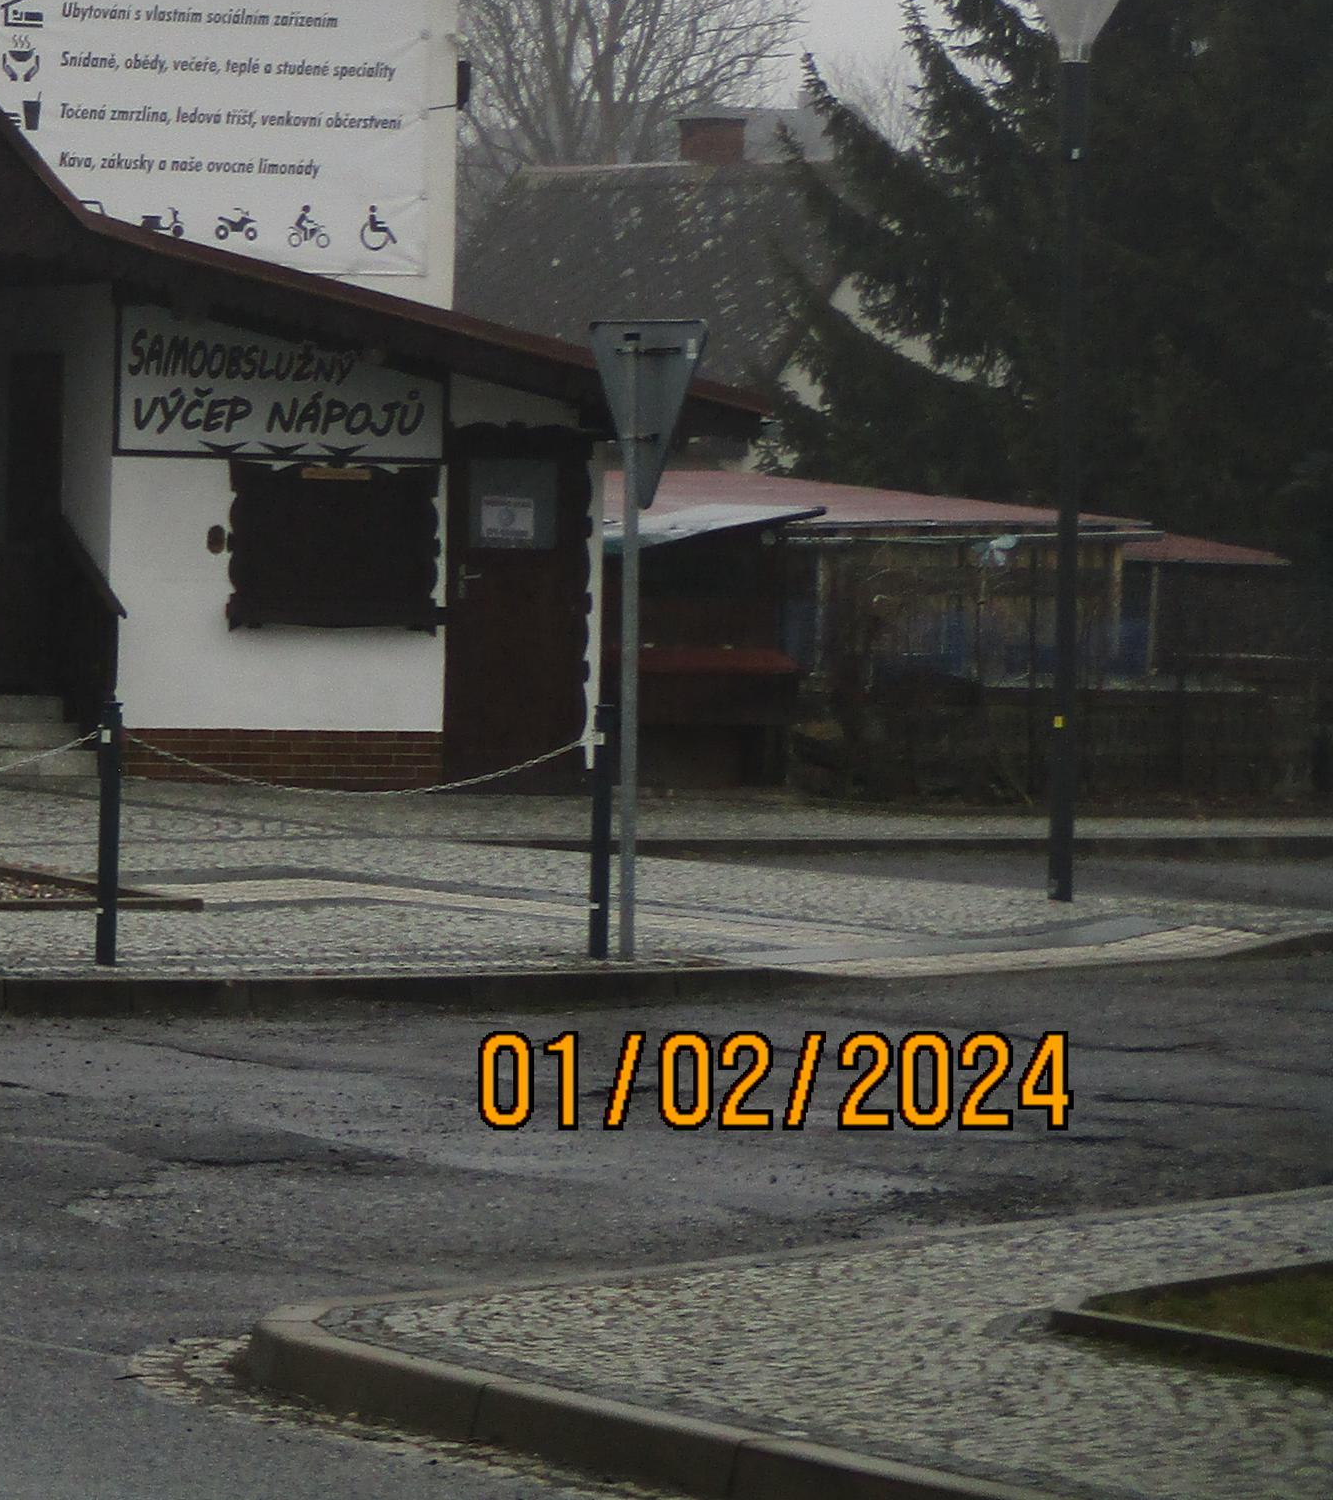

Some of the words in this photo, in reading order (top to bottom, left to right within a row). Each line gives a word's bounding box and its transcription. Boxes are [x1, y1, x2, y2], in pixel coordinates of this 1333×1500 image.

[62, 2, 132, 22] Ubytování
[135, 9, 141, 21] s
[146, 5, 202, 23] vlastním
[207, 8, 270, 26] sociálním
[274, 11, 338, 28] zařízením
[60, 51, 120, 71] Snídaně,
[125, 54, 168, 75] obědy,
[173, 56, 221, 75] večeře,
[226, 57, 260, 77] teplé
[264, 63, 272, 74] a
[276, 59, 330, 77] studené
[333, 62, 396, 81] speciality
[60, 103, 106, 121] Točená
[110, 105, 171, 125] zmrzlina,
[176, 106, 222, 125] ledová
[261, 111, 325, 128] venkovní
[325, 112, 403, 130] občerstvení
[59, 151, 96, 171] Káva,
[100, 153, 154, 173] zákusky
[158, 159, 167, 171] a
[171, 157, 203, 172] naše
[206, 158, 254, 174] ovocné
[258, 157, 320, 179] limonády
[128, 328, 355, 385] SAMOOBSLUŽNÝ
[134, 387, 253, 435] VÝČEP
[265, 389, 425, 437] NÁPOJŮ
